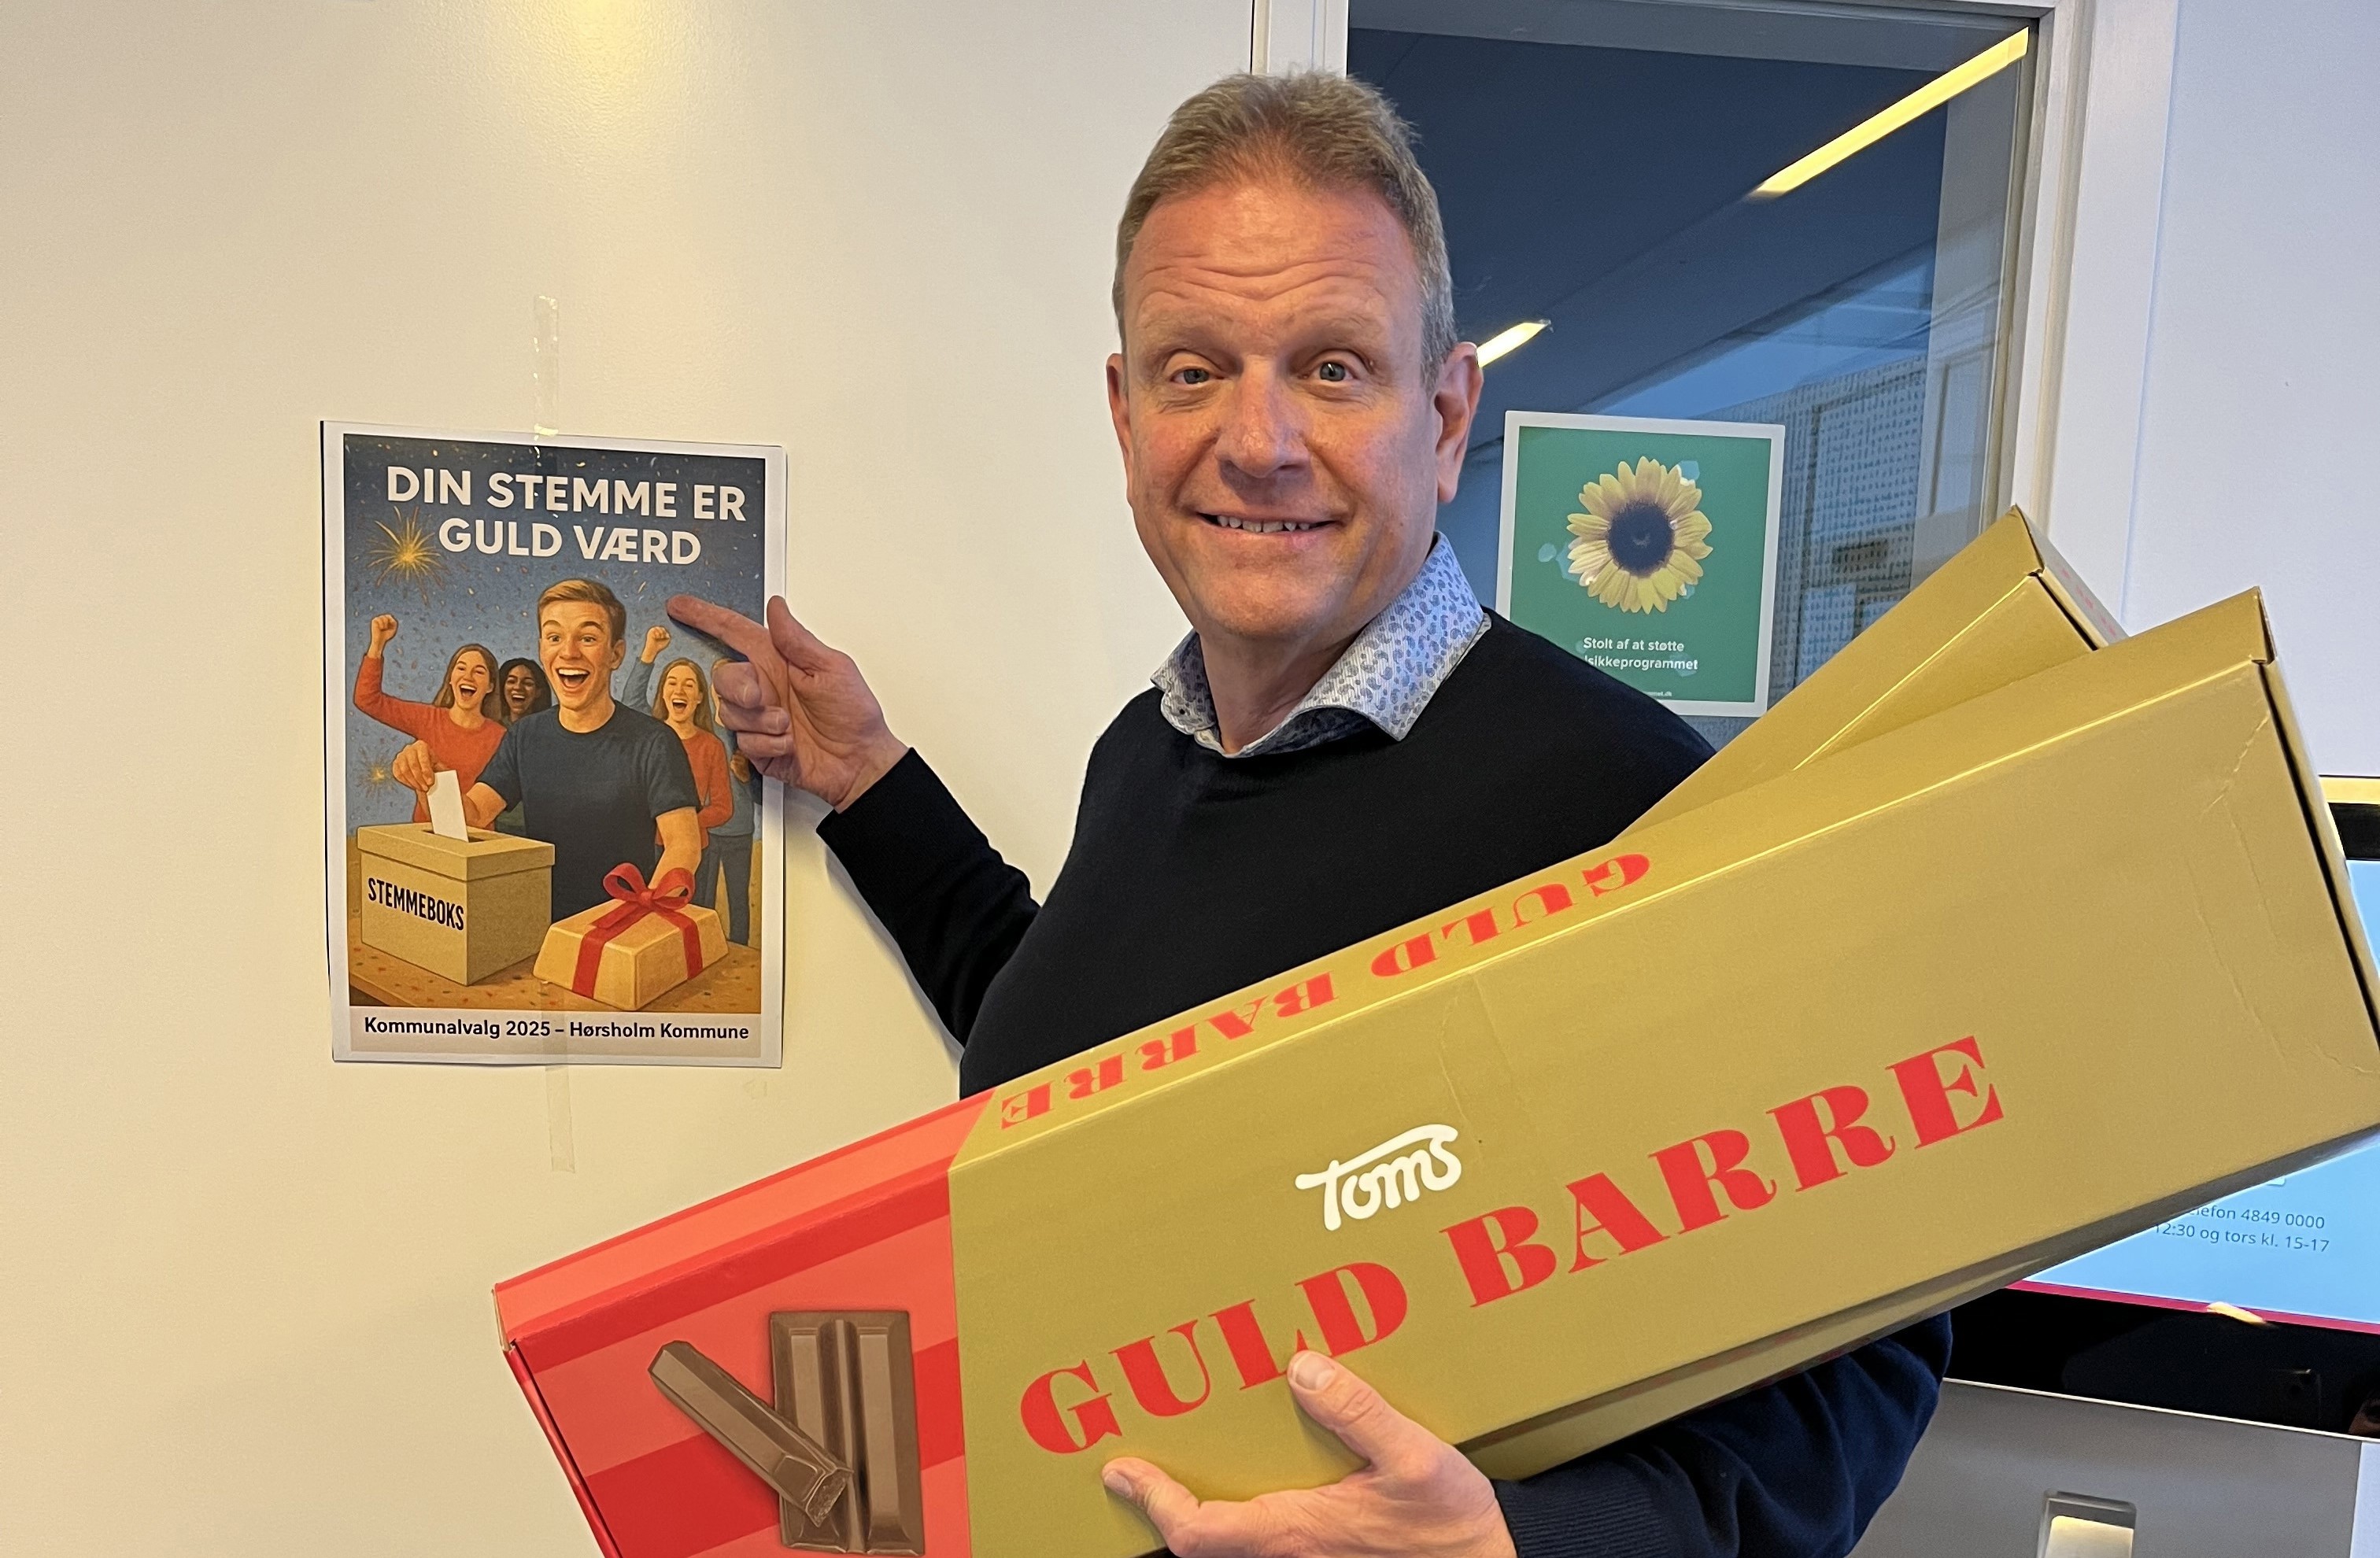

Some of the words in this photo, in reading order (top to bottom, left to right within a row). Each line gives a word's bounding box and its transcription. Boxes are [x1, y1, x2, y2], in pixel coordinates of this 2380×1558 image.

[387, 466, 471, 506] DIN
[486, 473, 677, 518] STEMME
[693, 484, 746, 522] ER
[438, 518, 563, 557] GULD
[573, 525, 701, 565] VÆRD
[1583, 637, 1613, 649] Stolt
[1616, 638, 1630, 650] af
[1632, 640, 1645, 651] at
[1647, 641, 1685, 652] støtte
[1584, 655, 1698, 670] lsikkeprogrammet
[367, 877, 465, 932] STEMMEBOKS
[1370, 853, 1650, 978] GULD
[364, 1017, 500, 1039] Kommunalvalg
[506, 1020, 551, 1036] 2025
[570, 1021, 655, 1038] Hørsholm
[660, 1023, 749, 1039] Kommune
[1001, 973, 1339, 1129] BARRE
[1295, 1124, 1462, 1231] Toms
[2200, 1229, 2219, 1244] og
[2225, 1231, 2256, 1244] tors
[2261, 1232, 2278, 1247] kl.
[2286, 1235, 2330, 1252] 15-17
[2241, 1209, 2280, 1224] 4849
[2285, 1213, 2325, 1229] 0000
[1019, 1261, 1409, 1455] GULD
[1439, 1036, 2004, 1308] BARRE
